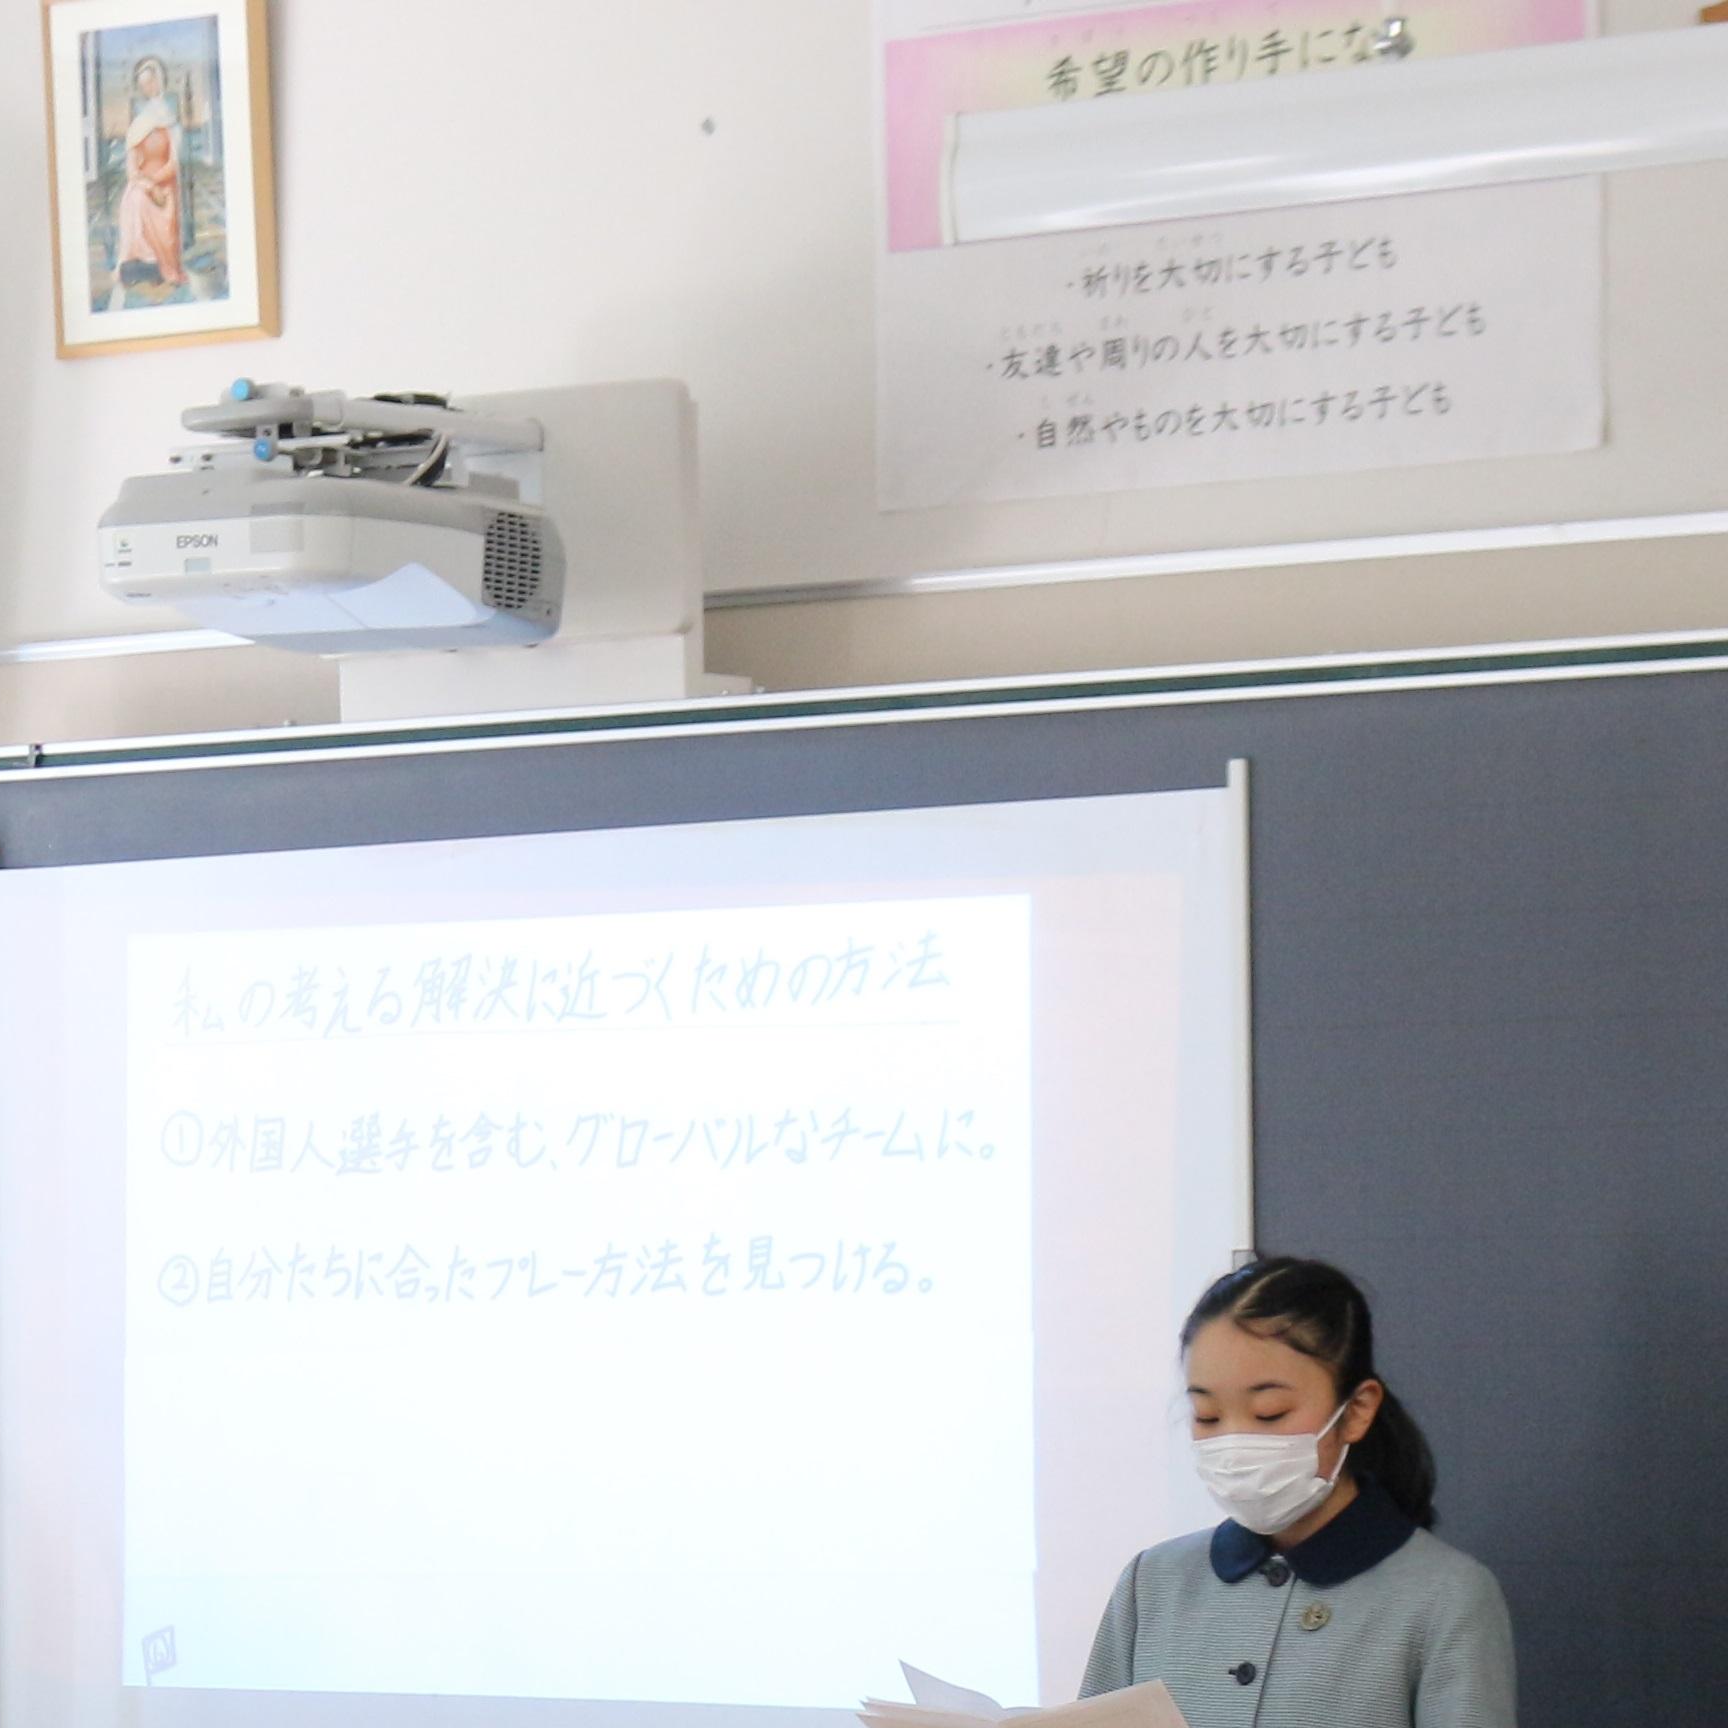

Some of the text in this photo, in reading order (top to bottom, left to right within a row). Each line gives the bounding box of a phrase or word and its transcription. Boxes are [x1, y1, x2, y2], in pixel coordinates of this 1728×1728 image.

[1046, 20, 1382, 98] 希望の作り手にな
[175, 534, 219, 549] EPSON
[159, 1107, 999, 1178] ①外国人選手を含む、グローバルなチームに。
[157, 1232, 936, 1307] ②自分たちに合ったプレー方法を見つける。
